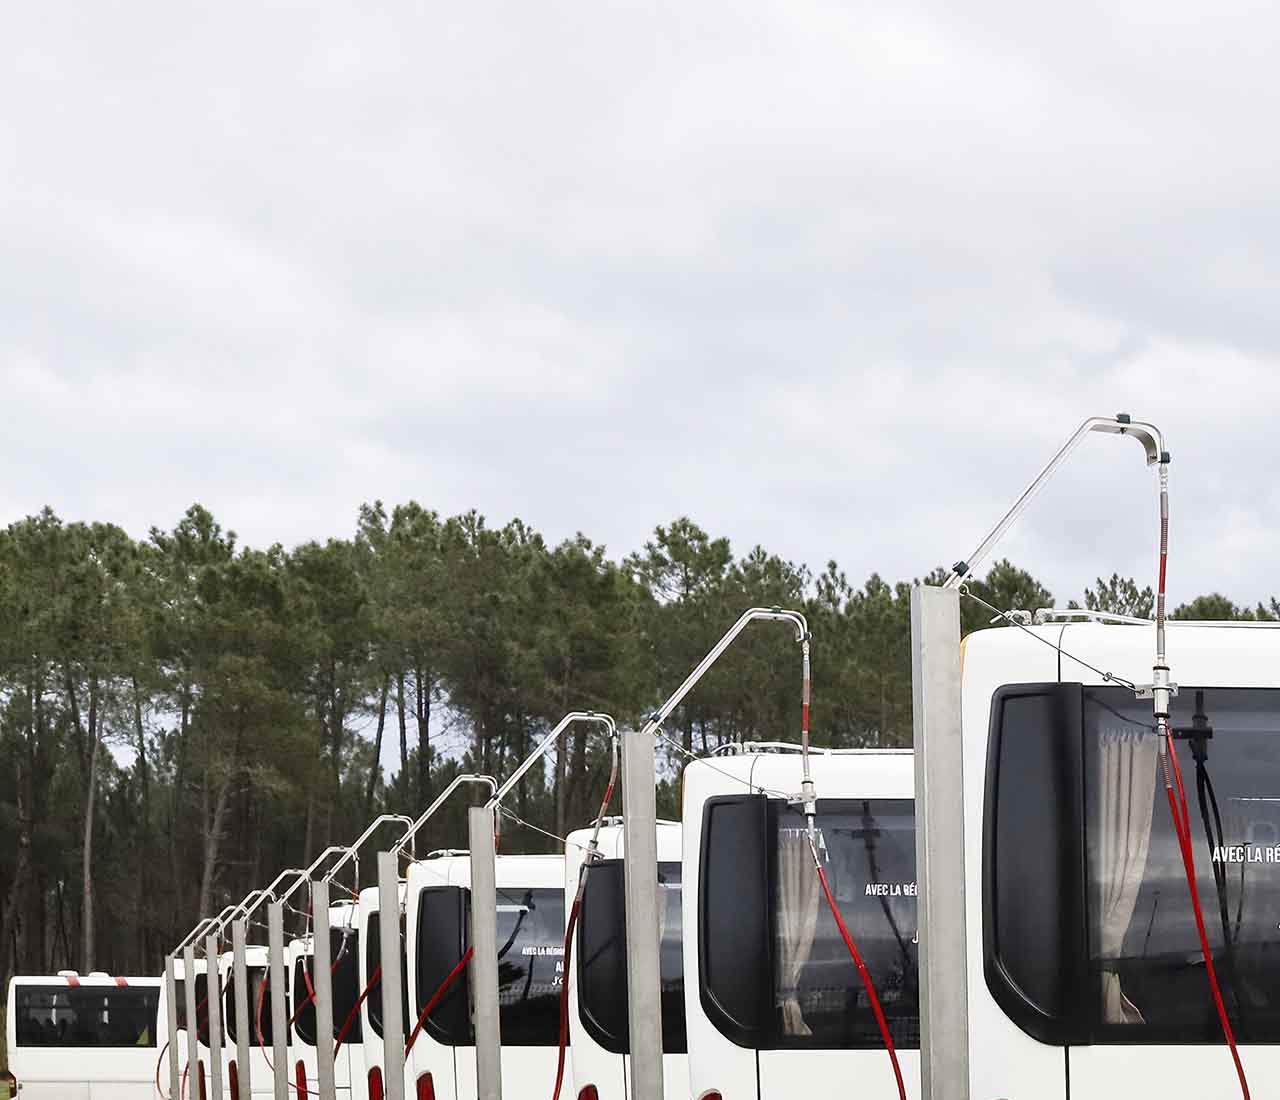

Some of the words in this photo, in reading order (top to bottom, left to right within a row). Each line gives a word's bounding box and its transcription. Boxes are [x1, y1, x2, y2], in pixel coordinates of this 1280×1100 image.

[1212, 846, 1245, 863] AVEC
[1247, 846, 1263, 863] LA
[865, 883, 889, 896] AVEC
[889, 883, 902, 896] LA
[521, 946, 538, 956] AVEC
